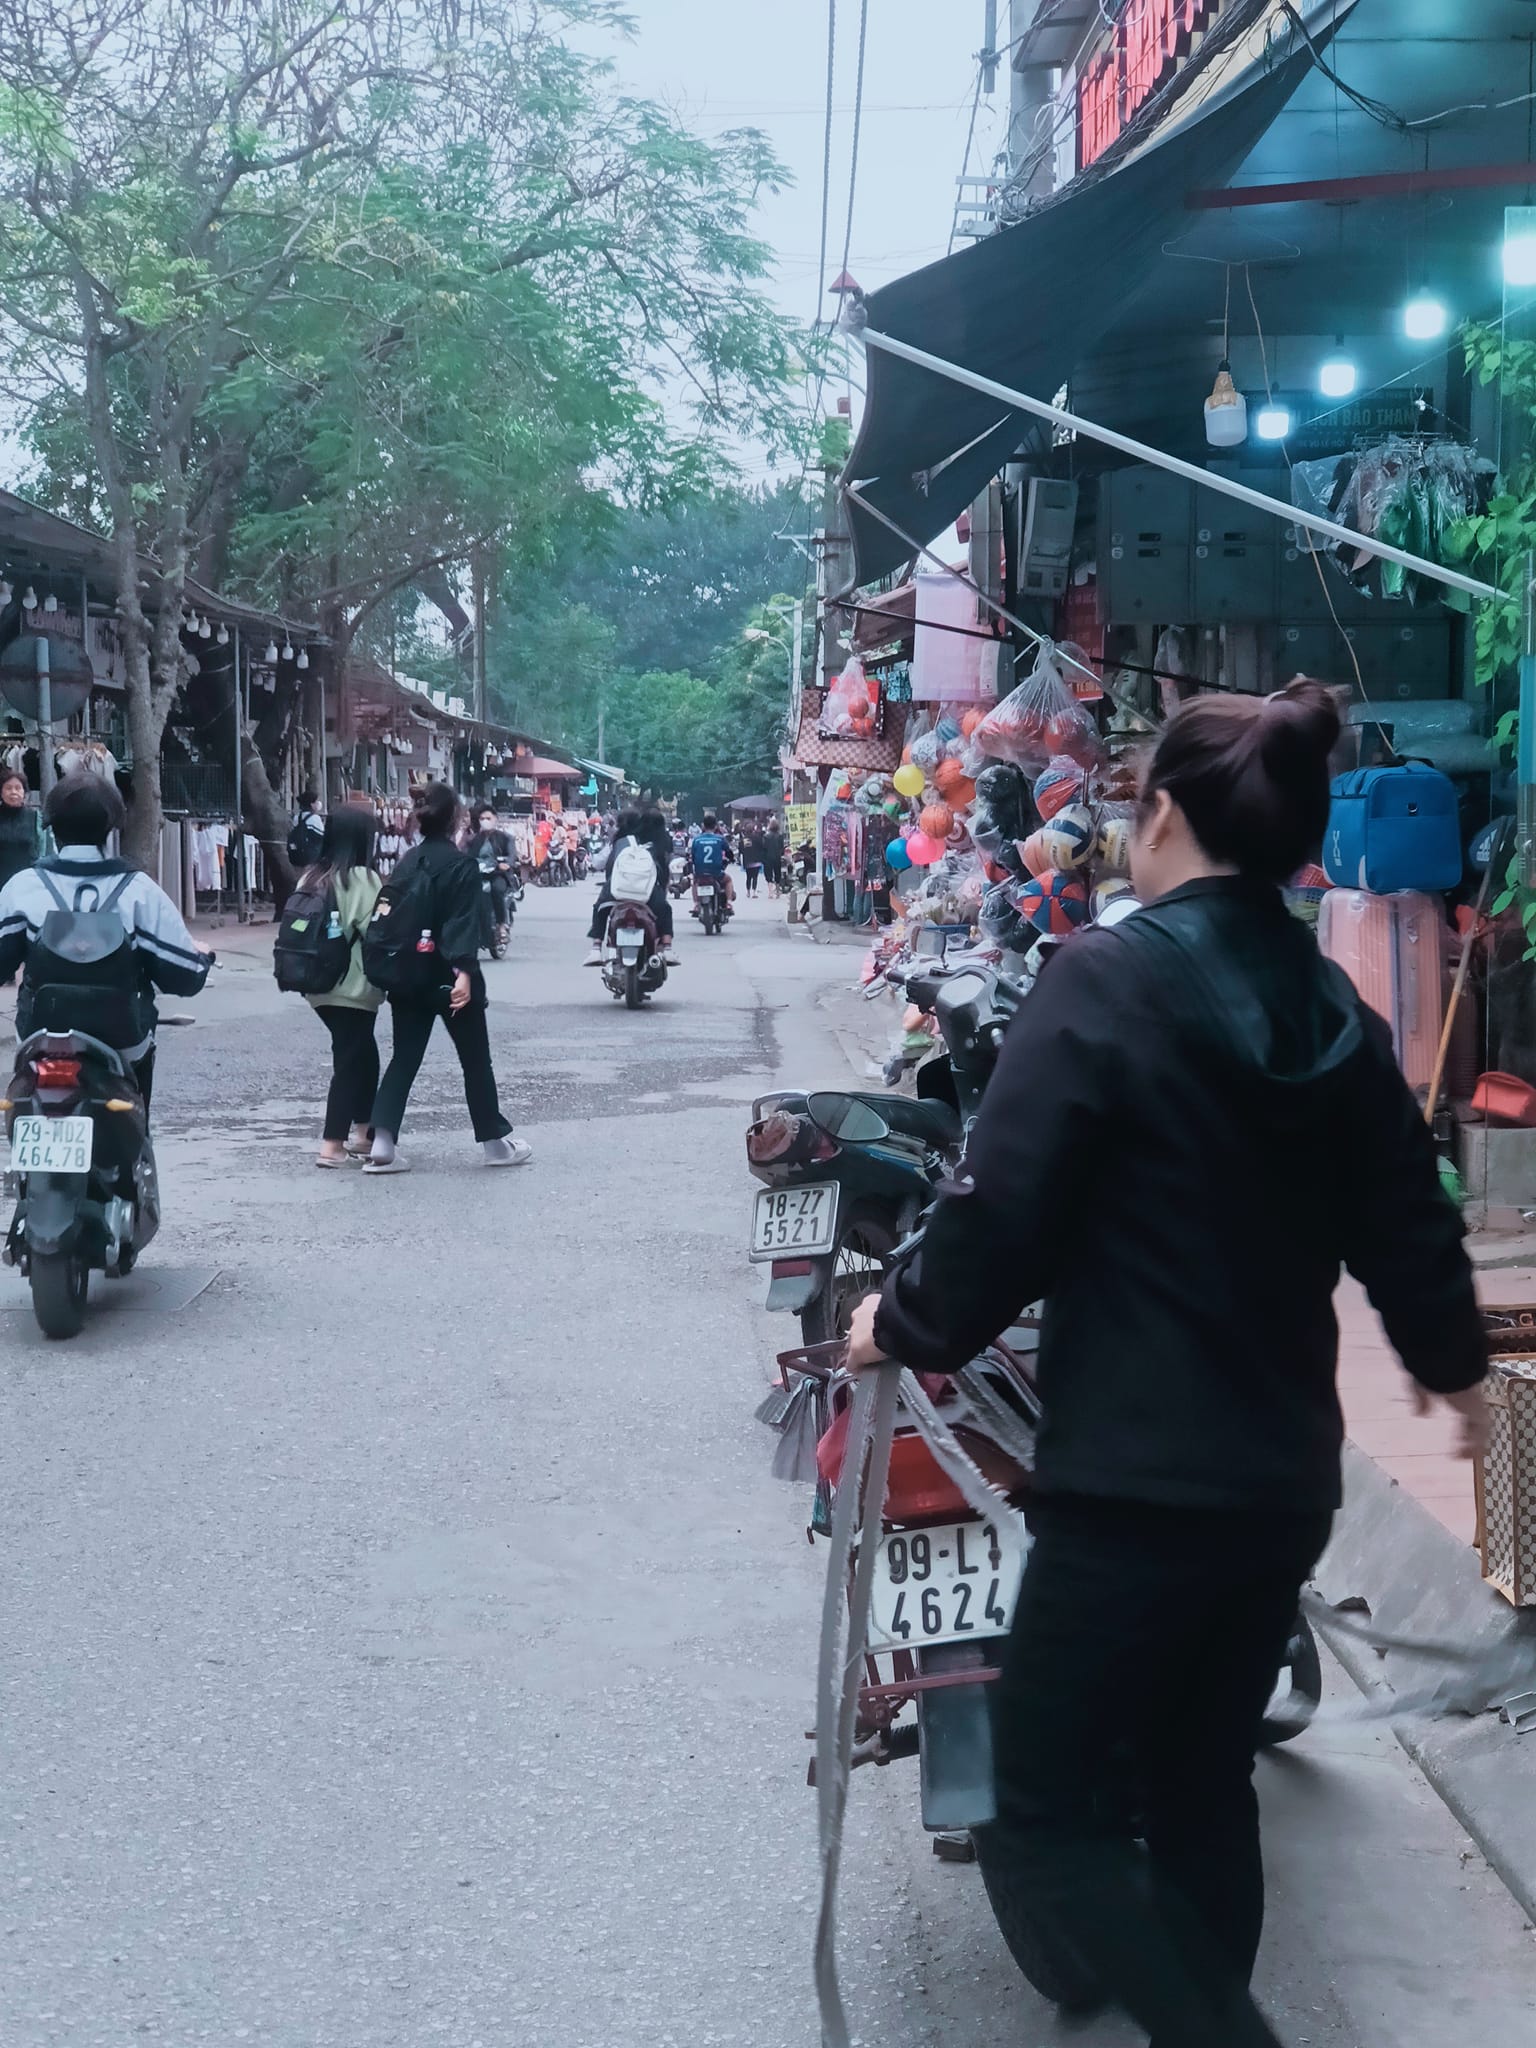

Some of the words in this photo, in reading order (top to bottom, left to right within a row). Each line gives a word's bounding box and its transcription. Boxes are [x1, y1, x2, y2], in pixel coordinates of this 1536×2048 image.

[703, 845, 713, 863] 2
[18, 1146, 86, 1168] 464.78
[766, 1189, 825, 1218] 18-Z7
[763, 1217, 819, 1246] 5521
[888, 1524, 1003, 1584] 99-L1
[891, 1578, 1005, 1639] 4624
